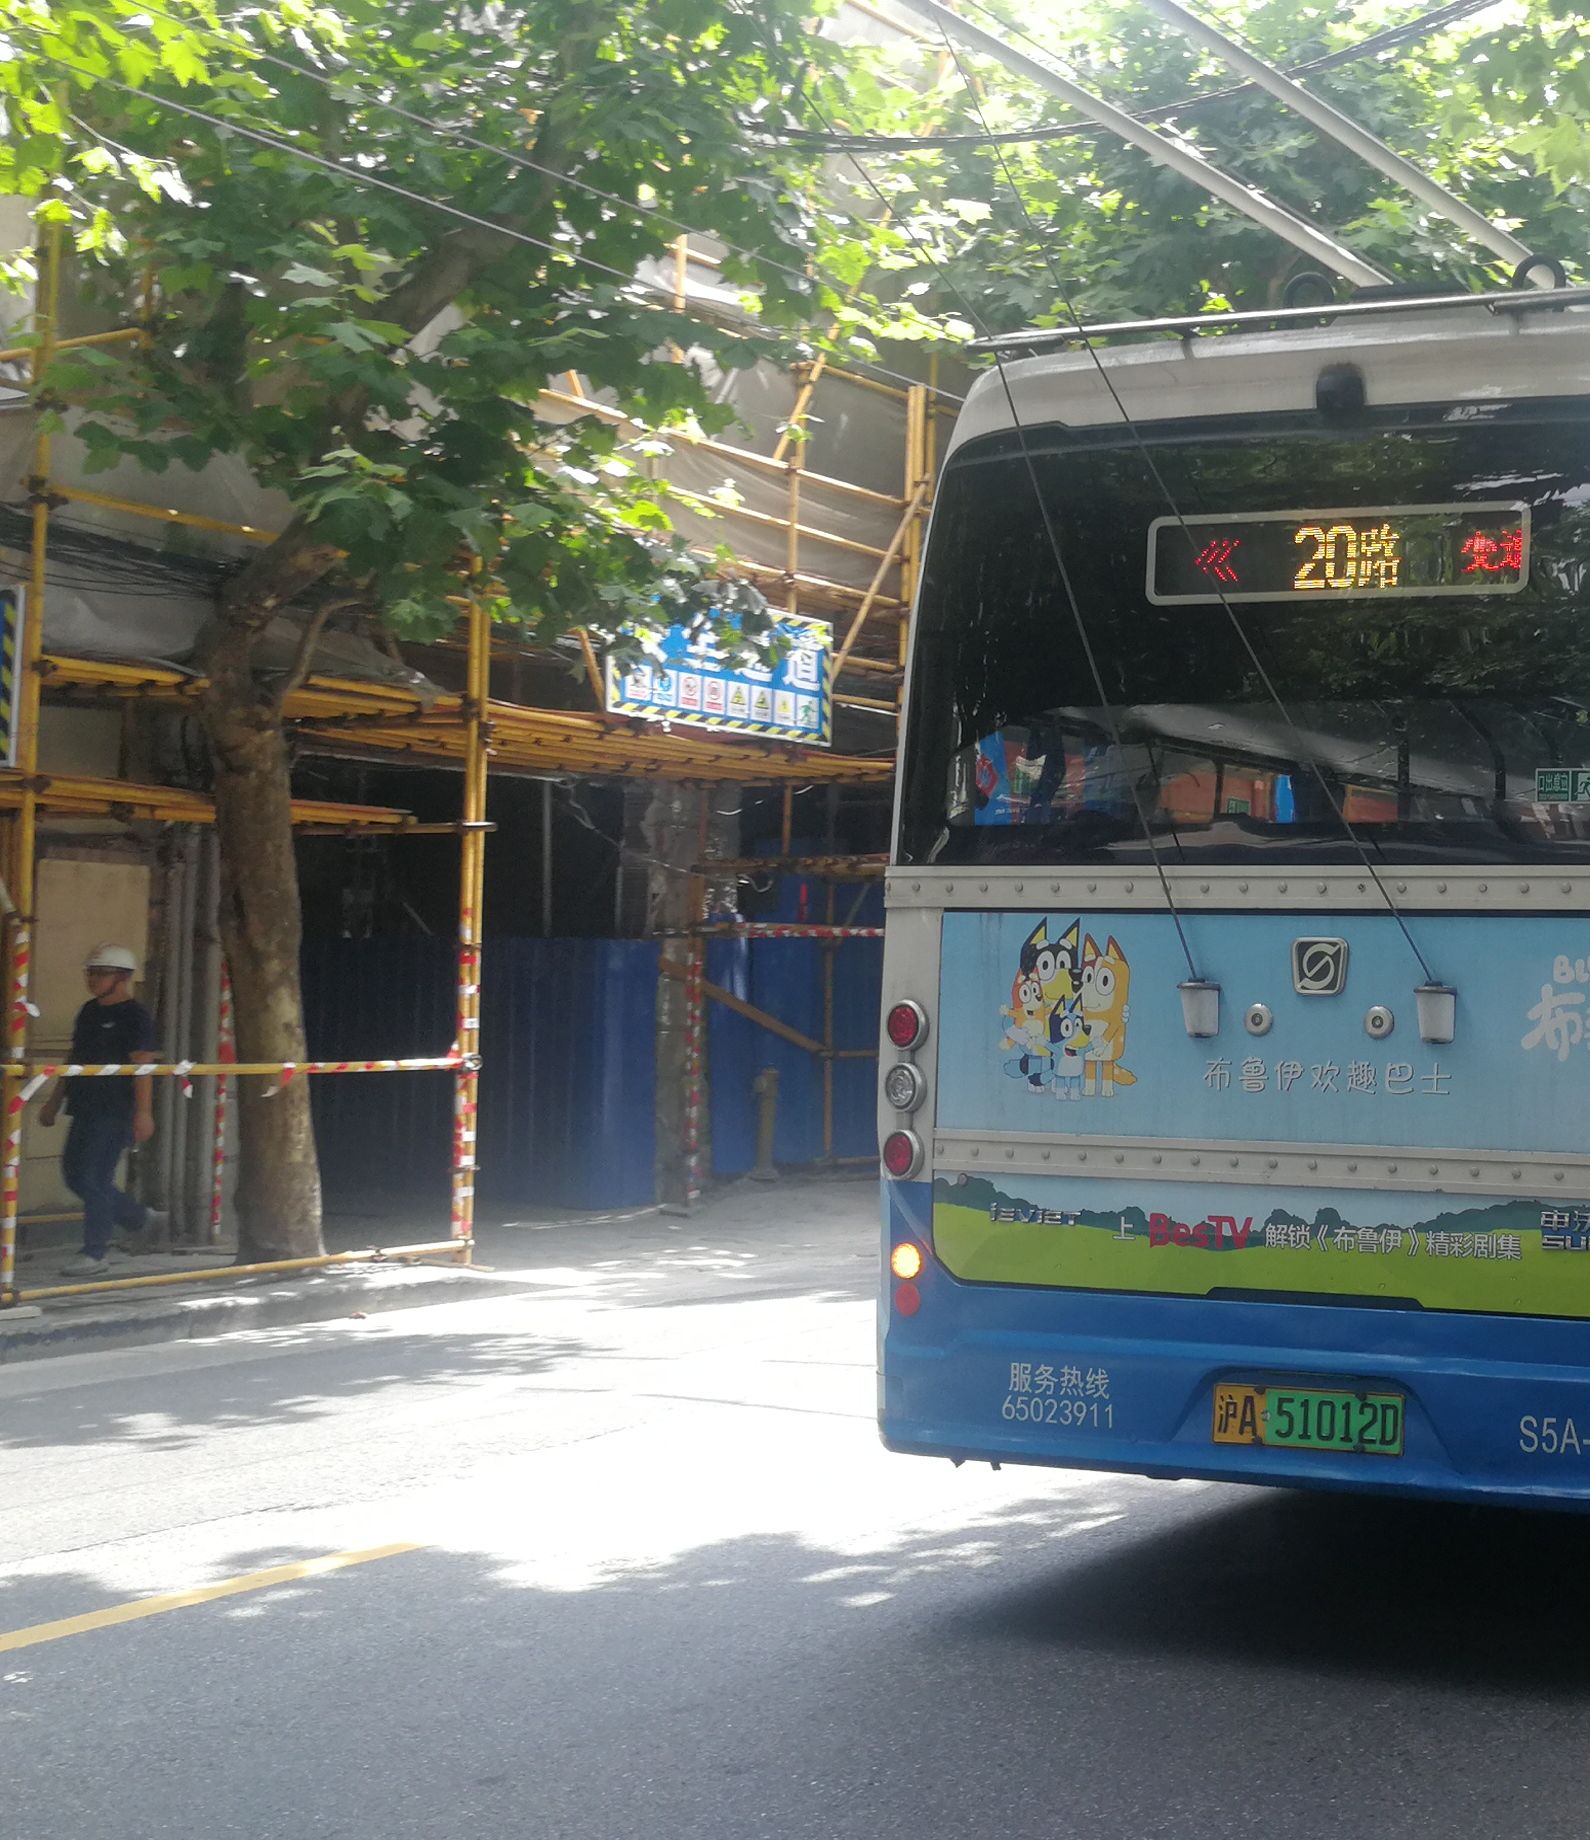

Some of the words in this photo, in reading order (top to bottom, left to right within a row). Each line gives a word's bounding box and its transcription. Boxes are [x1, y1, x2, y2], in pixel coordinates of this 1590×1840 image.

[1294, 523, 1401, 589] 20路
[1203, 1057, 1453, 1095] 布鲁伊欢趣巴士
[1008, 1362, 1111, 1400] 服务热线
[1001, 1394, 1114, 1430] 65023911
